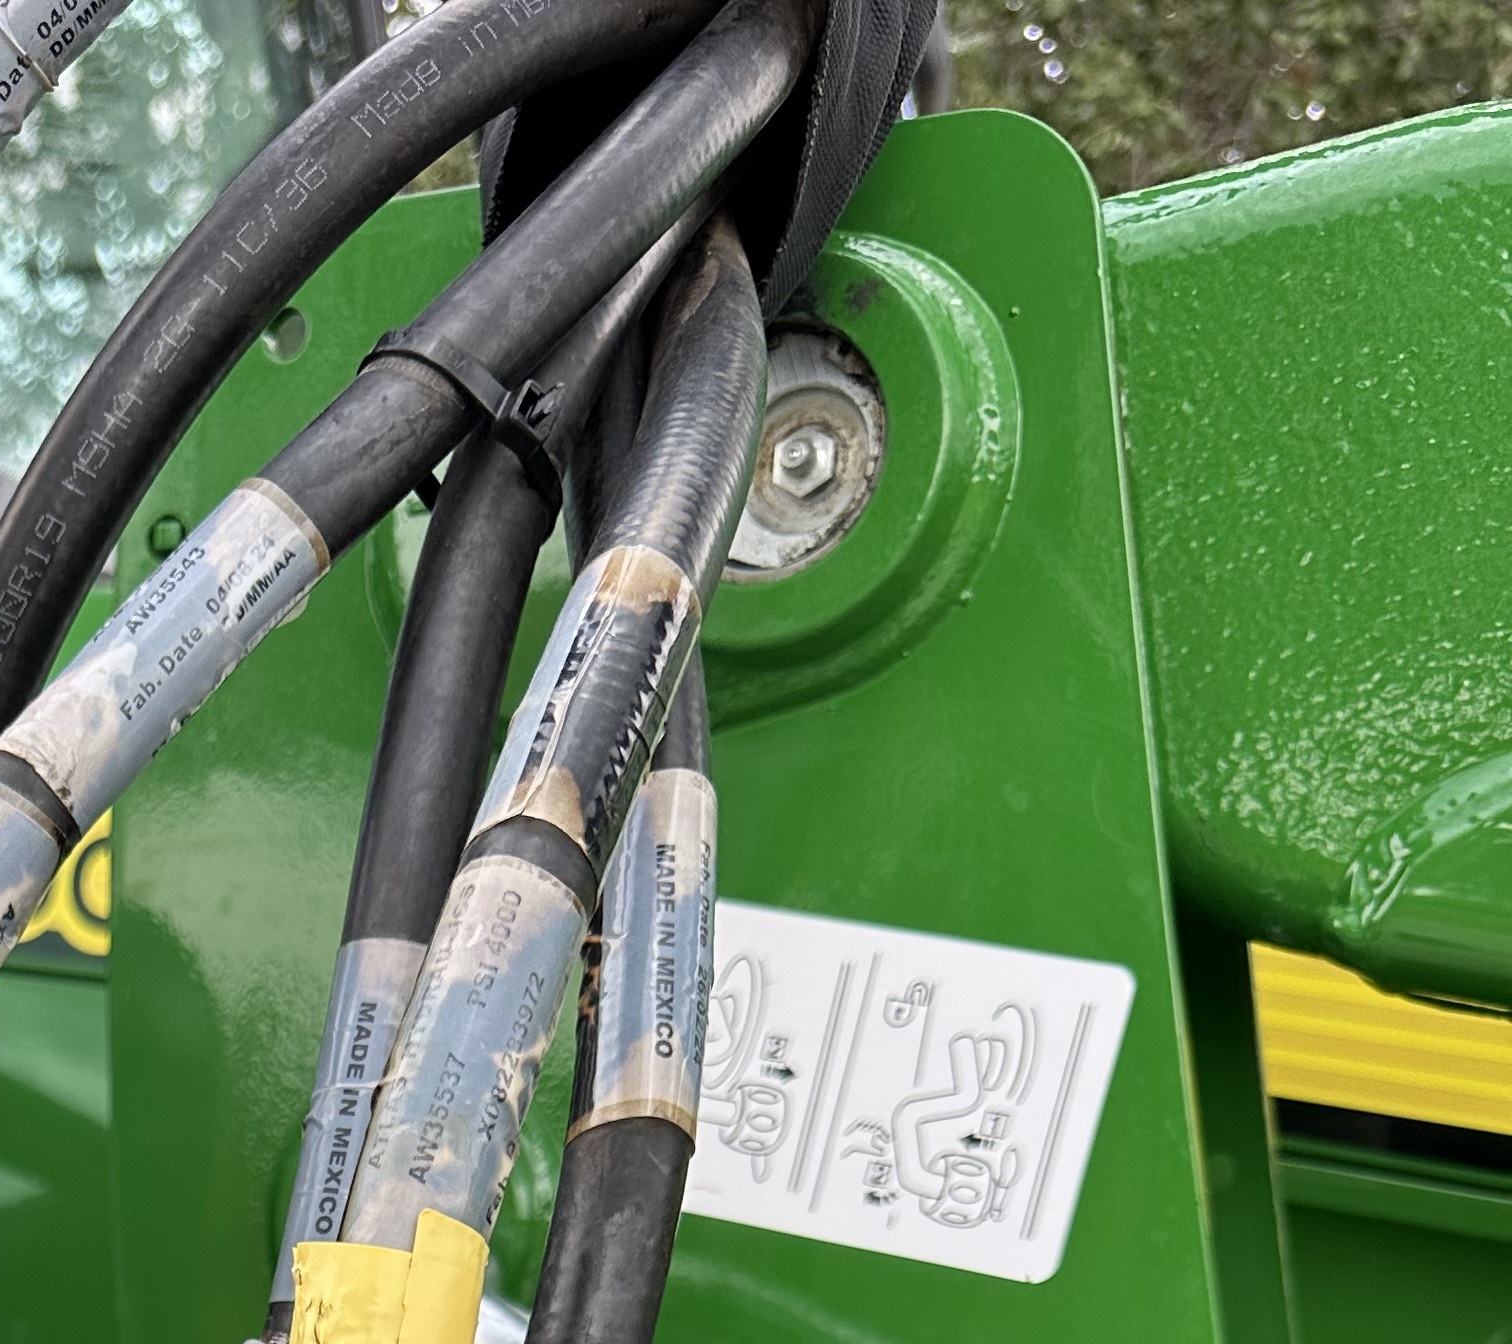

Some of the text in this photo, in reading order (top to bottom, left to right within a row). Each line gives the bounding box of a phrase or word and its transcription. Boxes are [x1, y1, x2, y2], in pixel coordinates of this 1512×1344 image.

[350, 60, 443, 139] Made
[458, 21, 497, 57] in
[125, 546, 206, 635] AW35543
[119, 678, 162, 721] Fab.
[158, 626, 204, 676] Date
[467, 889, 522, 1009] PSI 4000
[653, 843, 676, 1060] MADE IN MEXICO
[314, 1001, 378, 1236] MADE IN MEXICO
[408, 1051, 466, 1185] AW35537
